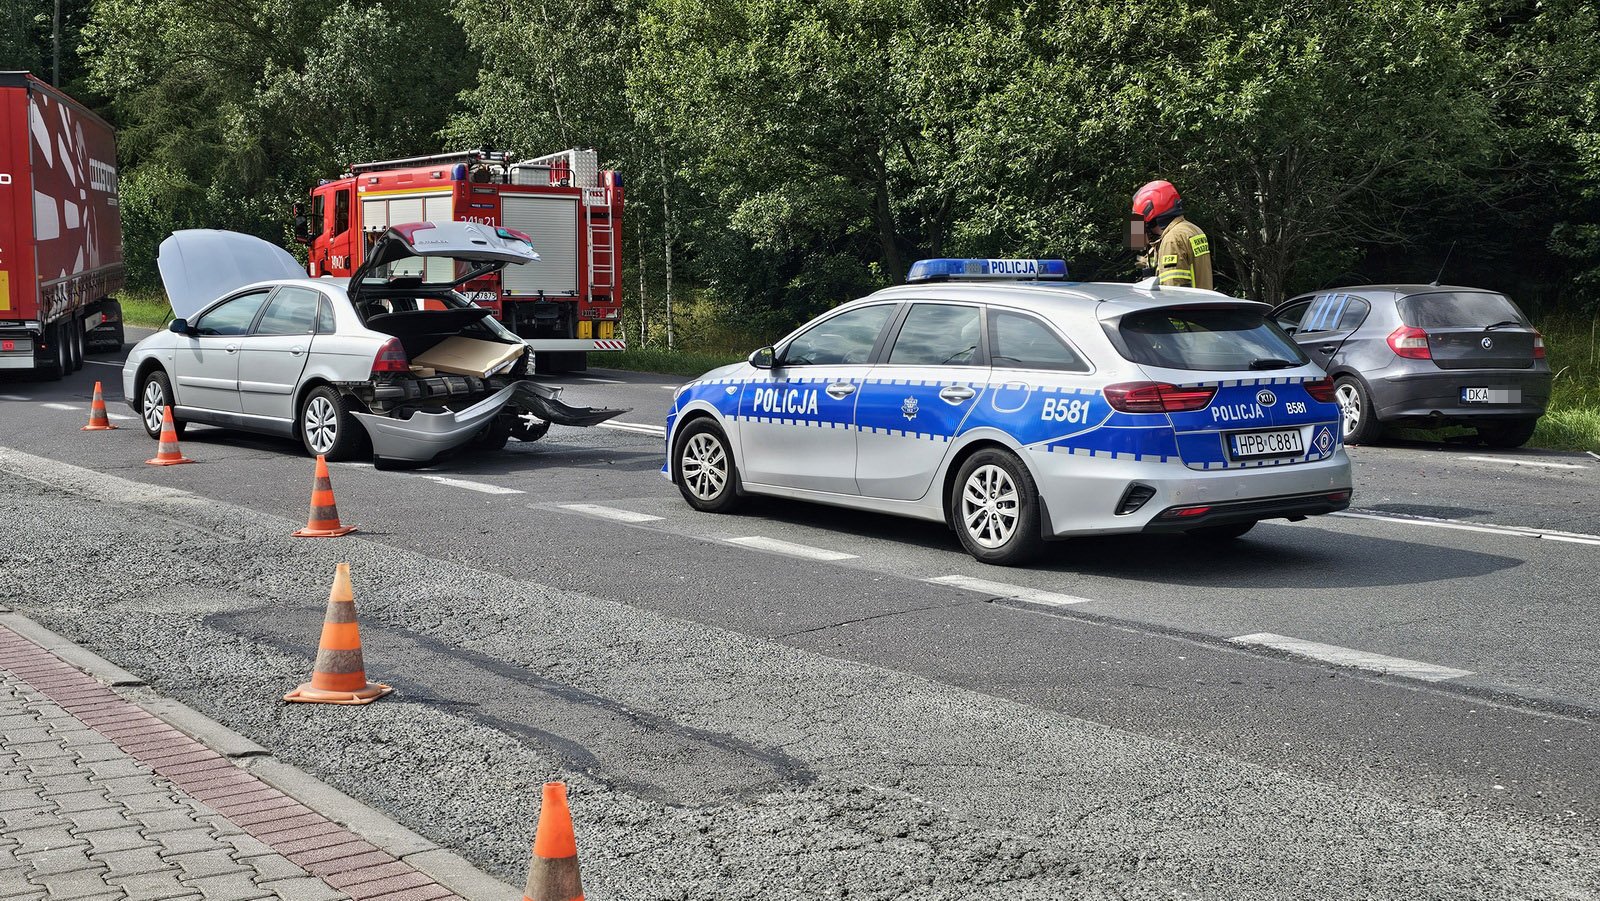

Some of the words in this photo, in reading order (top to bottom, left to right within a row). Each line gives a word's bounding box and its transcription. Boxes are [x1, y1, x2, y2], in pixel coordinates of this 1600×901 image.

[991, 261, 1036, 274] POLICJA
[753, 387, 819, 415] POLICJA
[1260, 394, 1274, 403] KIA
[1469, 389, 1488, 400] DKA
[1041, 398, 1090, 424] B581
[1211, 403, 1265, 422] POLICJA
[1286, 402, 1307, 415] B581
[1239, 435, 1265, 454] HPB
[1267, 432, 1299, 452] C881
[1322, 436, 1328, 446] R
